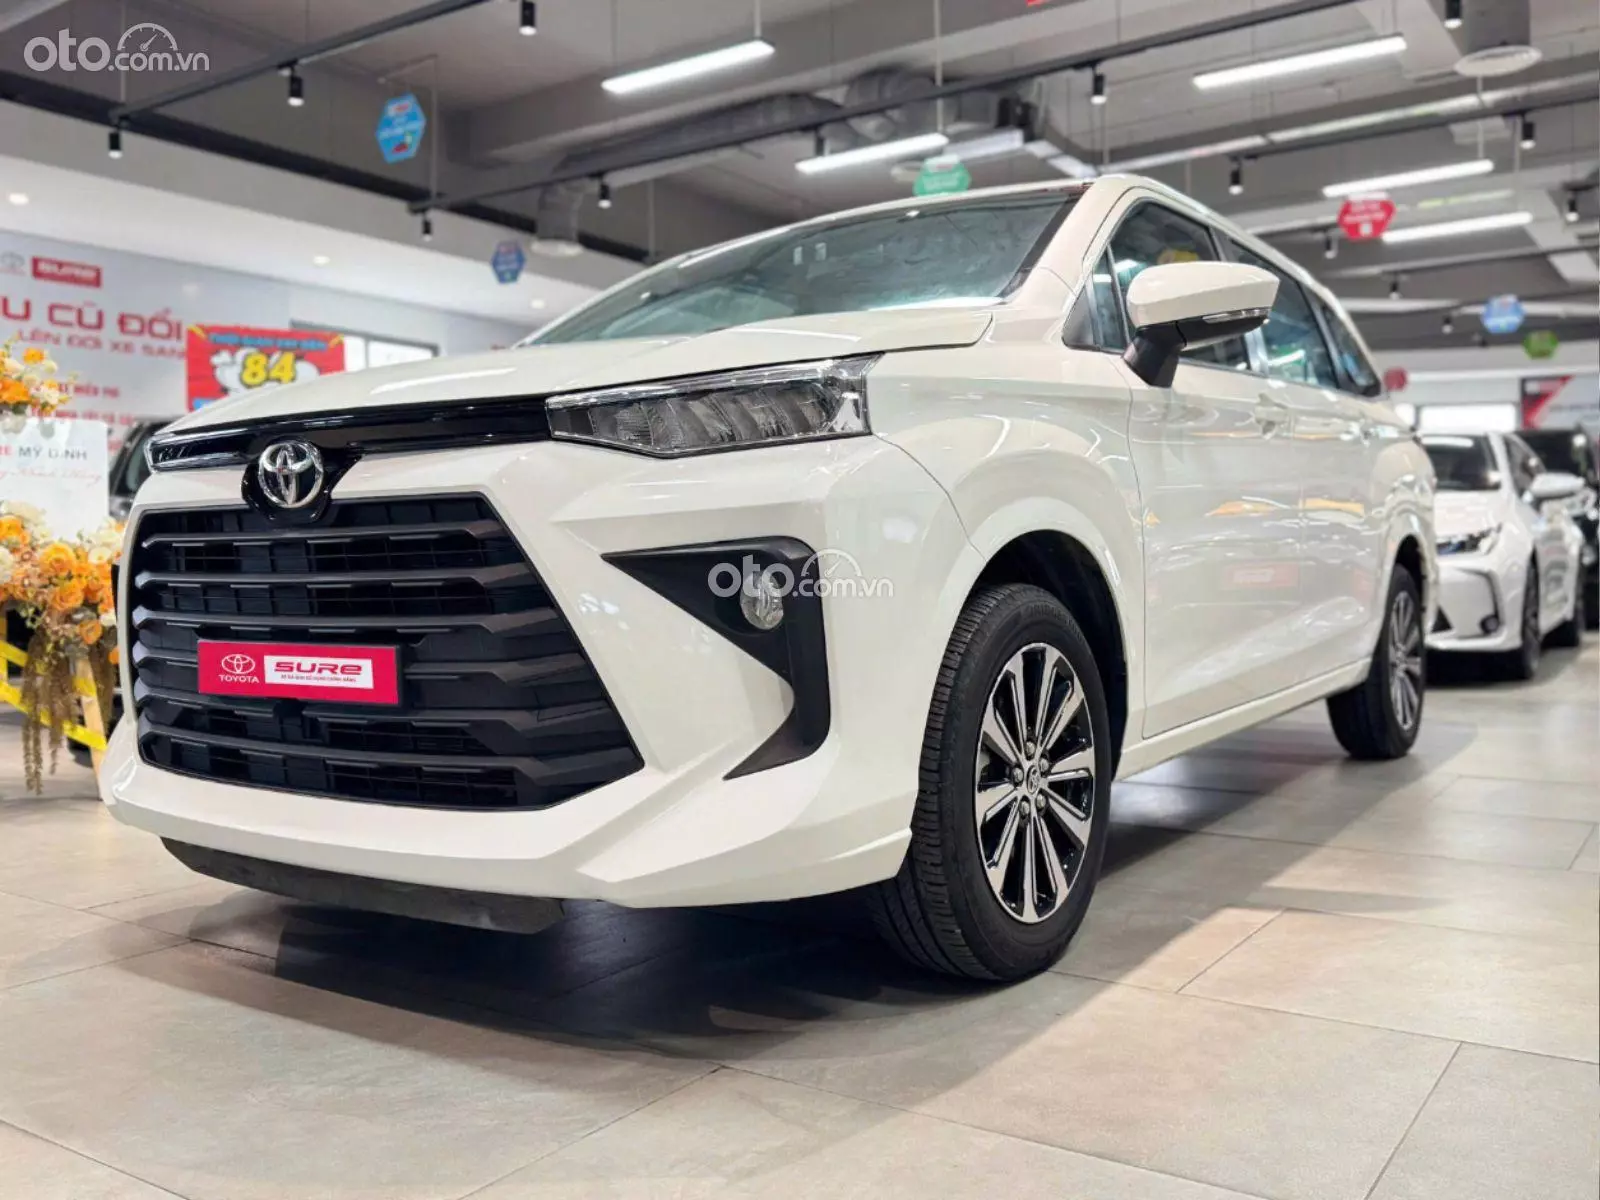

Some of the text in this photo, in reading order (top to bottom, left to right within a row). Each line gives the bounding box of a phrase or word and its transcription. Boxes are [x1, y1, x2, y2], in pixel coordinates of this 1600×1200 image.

[48, 300, 104, 330] CŨ
[117, 307, 183, 341] ĐỔI
[240, 351, 297, 388] 84
[218, 674, 259, 684] TOYOTA
[274, 661, 362, 675] SURE
